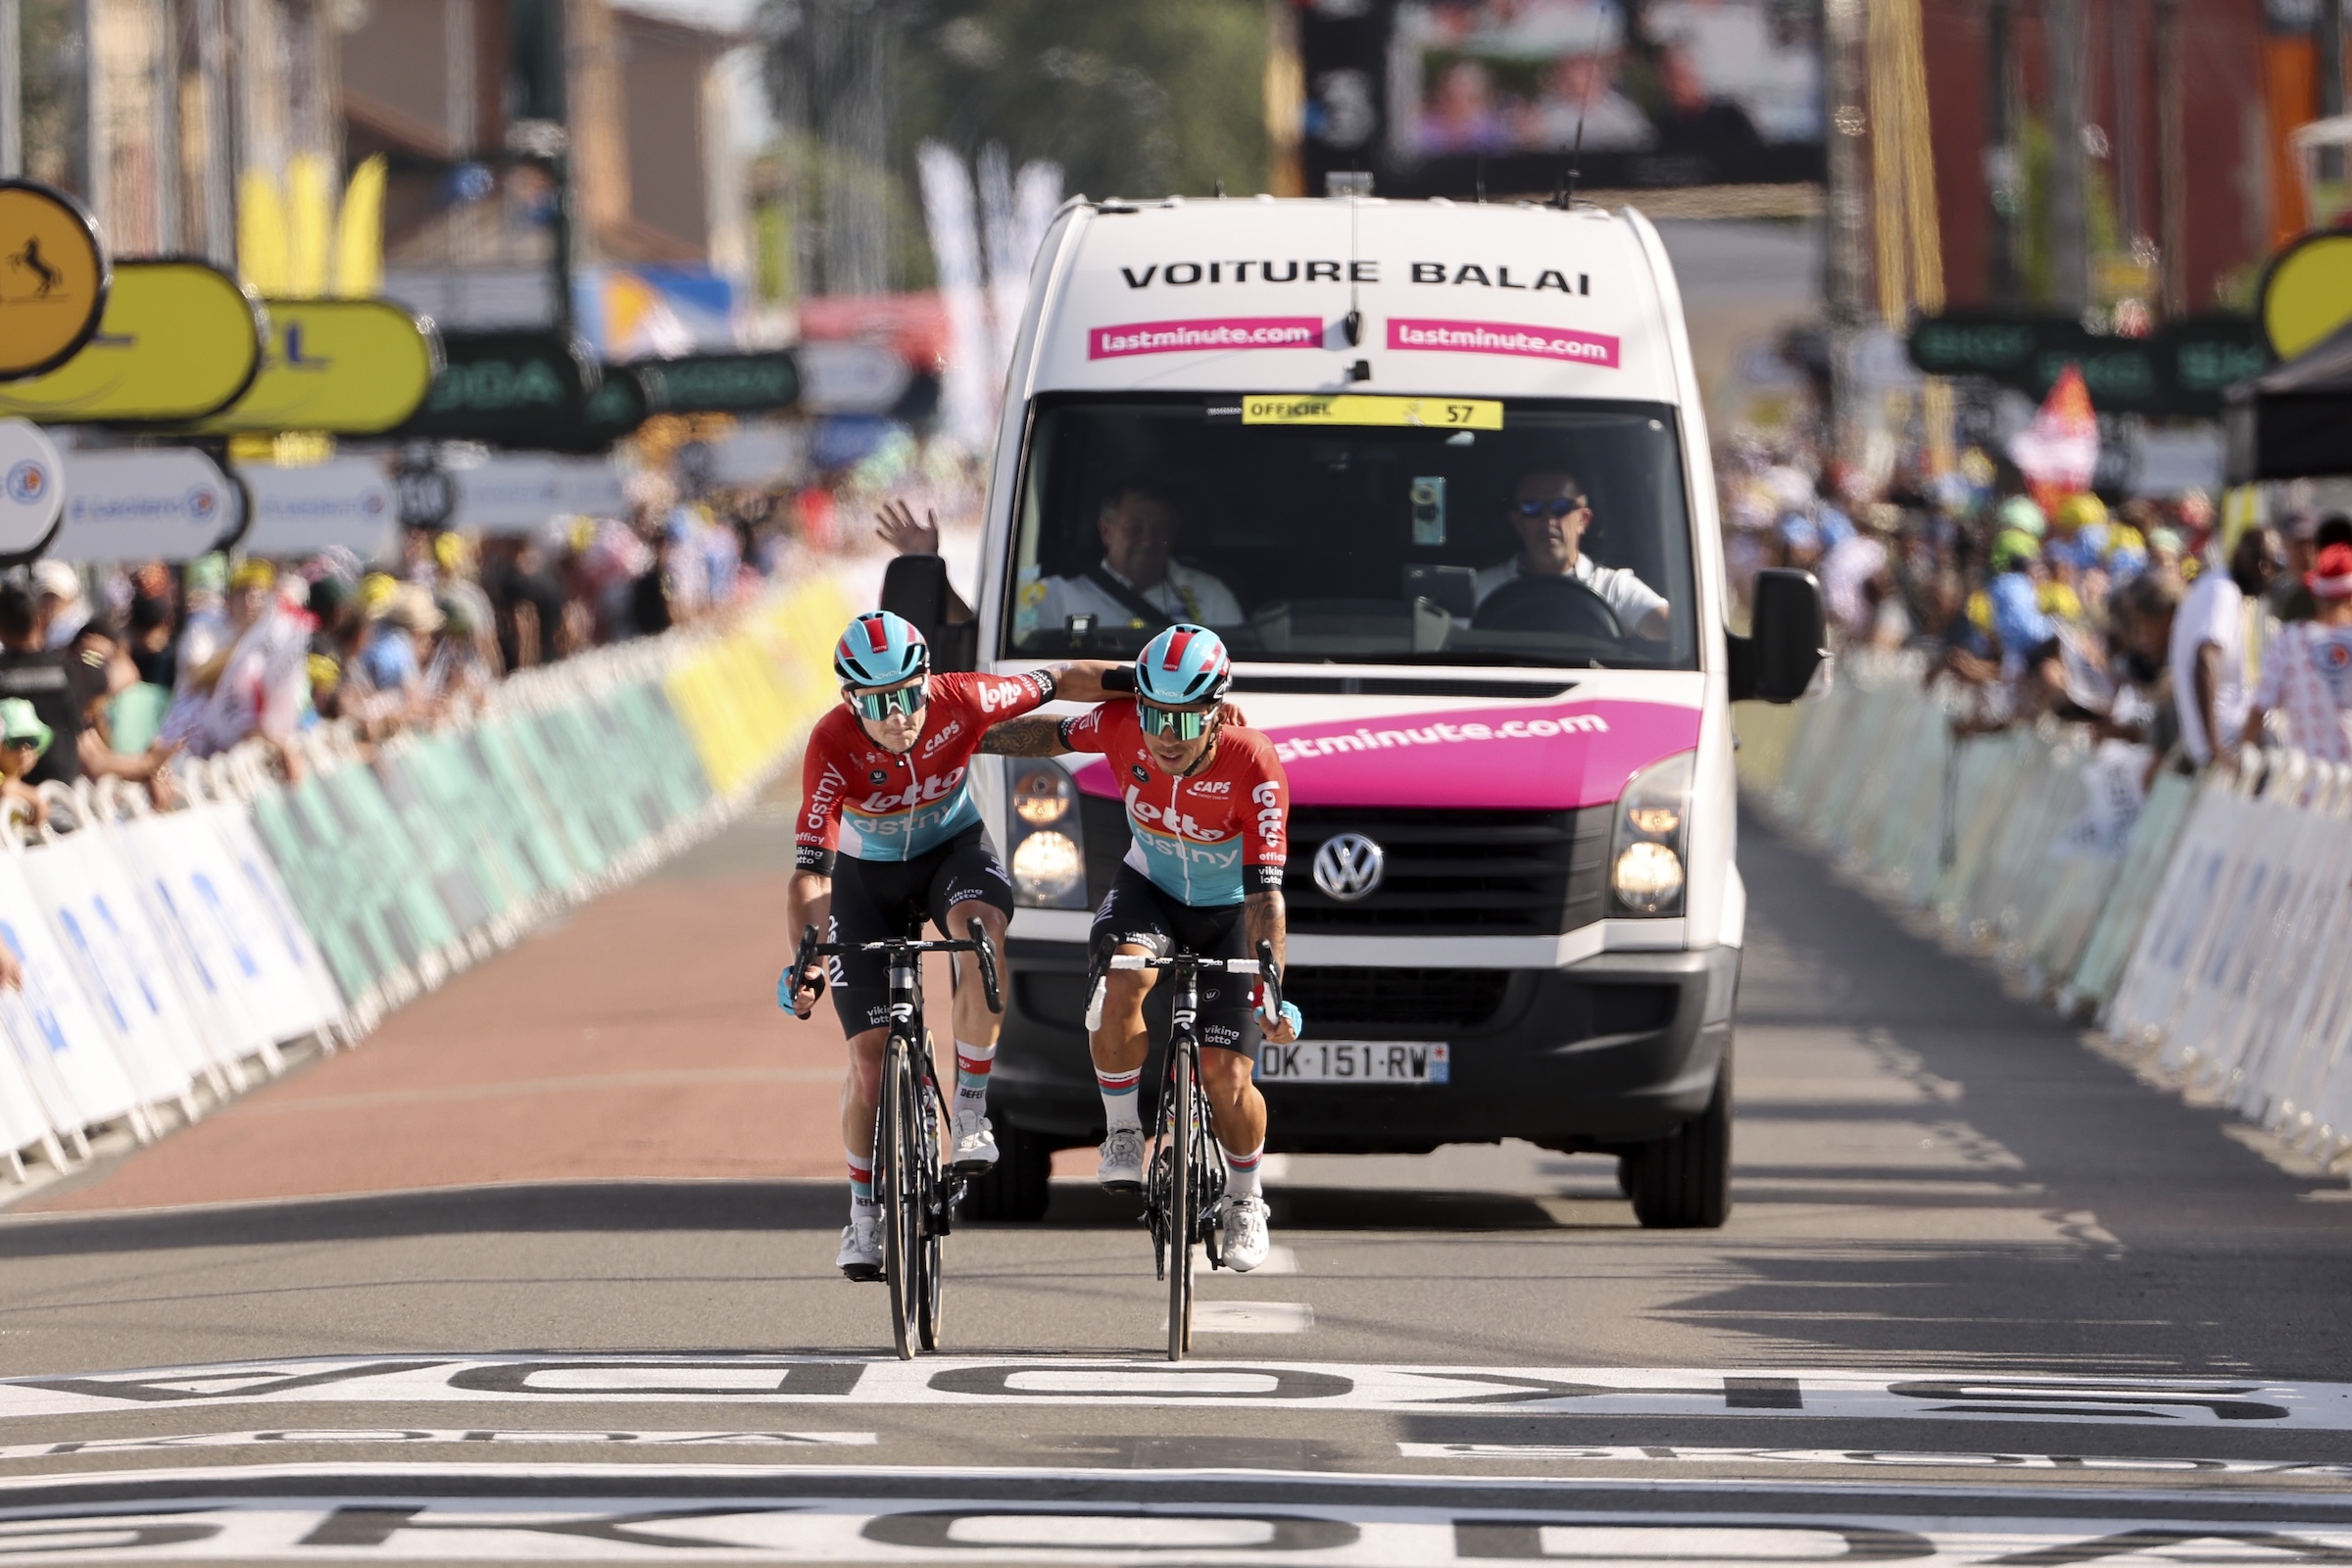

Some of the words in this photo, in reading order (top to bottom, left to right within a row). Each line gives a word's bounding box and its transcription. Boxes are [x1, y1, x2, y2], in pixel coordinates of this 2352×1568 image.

[1121, 260, 1380, 289] VOITURE
[1411, 262, 1591, 296] BALAI
[1102, 325, 1311, 353] lastminute.com
[1398, 323, 1608, 361] lastminute.com
[1250, 402, 1332, 416] OFFICIEL
[1446, 404, 1474, 422] 57
[924, 719, 959, 752] CAPS
[1274, 713, 1610, 763] stminute.com
[1193, 780, 1232, 794] CAPS
[797, 846, 823, 859] iking
[870, 1013, 891, 1025] lott
[1204, 1025, 1240, 1040] viking
[1204, 1036, 1232, 1046] lotto
[0, 1429, 823, 1455] KODA
